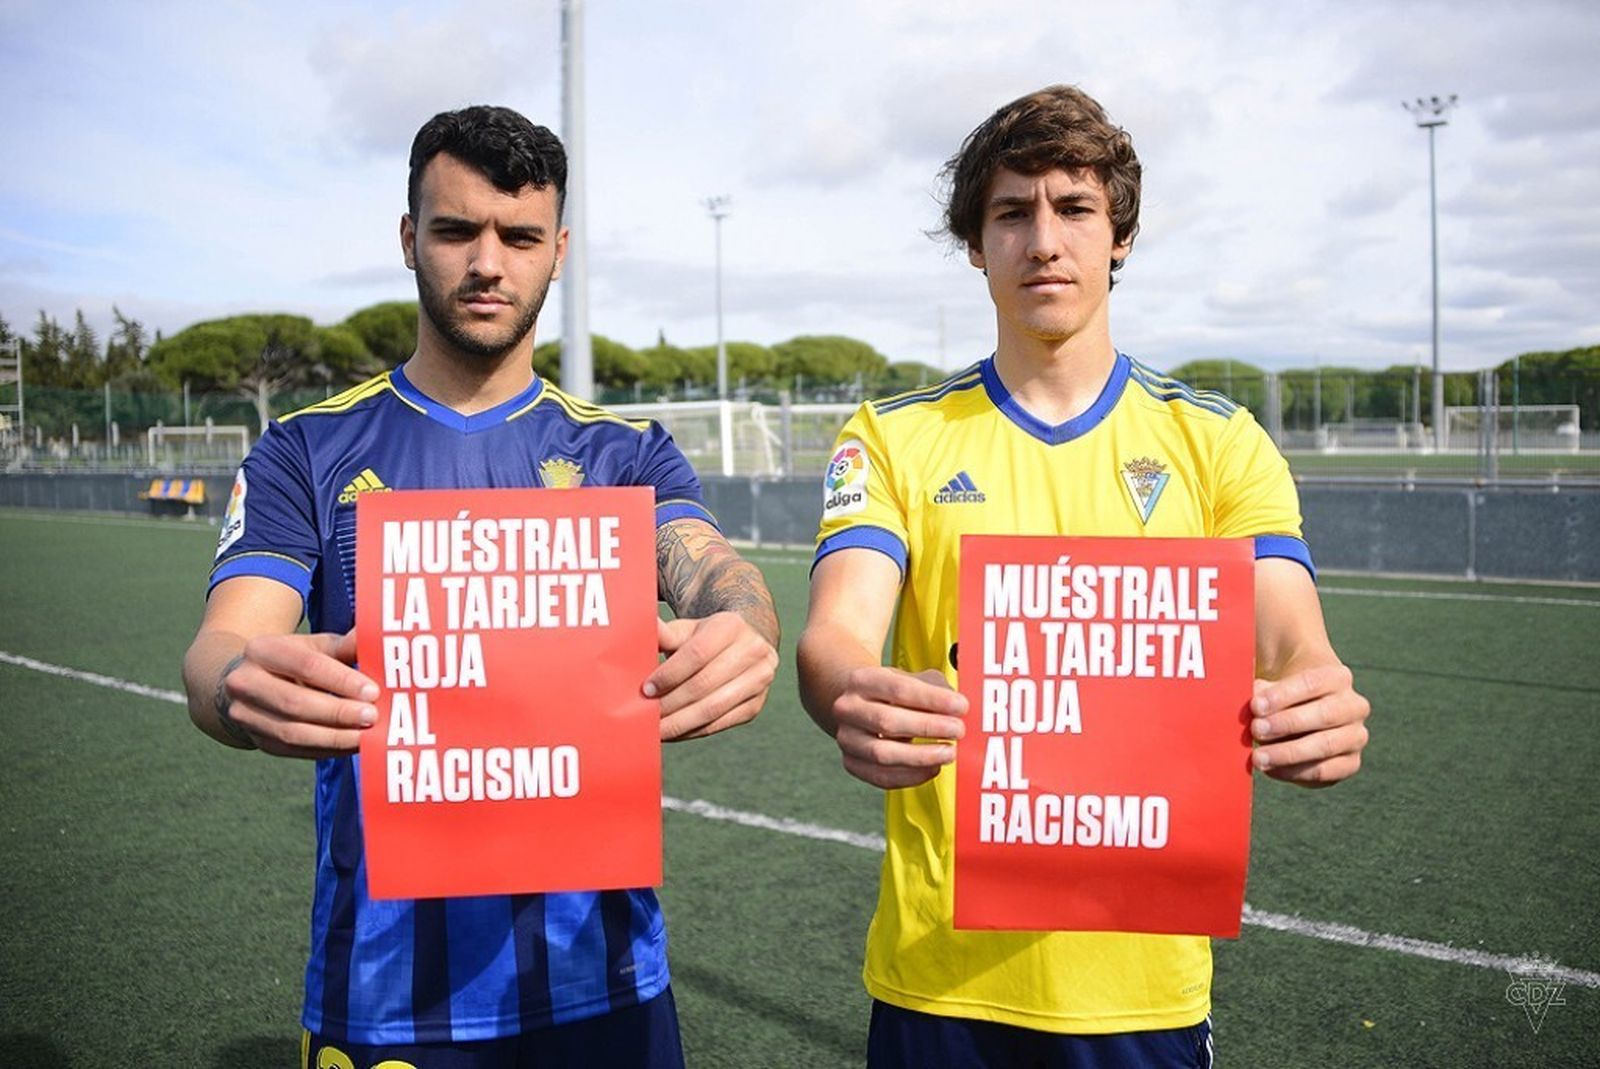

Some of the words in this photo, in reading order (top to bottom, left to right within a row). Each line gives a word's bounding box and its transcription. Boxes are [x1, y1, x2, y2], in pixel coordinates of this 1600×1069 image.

[934, 491, 987, 504] adidas
[381, 509, 622, 575] MUÉSTRALE
[381, 576, 432, 633] LA
[440, 571, 611, 631] TARJETA
[983, 555, 1219, 622] MUÉSTRALE
[382, 632, 487, 689] ROJA
[982, 620, 1031, 676] LA
[1039, 621, 1206, 679] TARJETA
[386, 692, 437, 747] AL
[982, 677, 1082, 734] ROJA
[386, 745, 580, 803] RACISMO
[981, 735, 1030, 790] AL
[979, 792, 1169, 849] RACISMO
